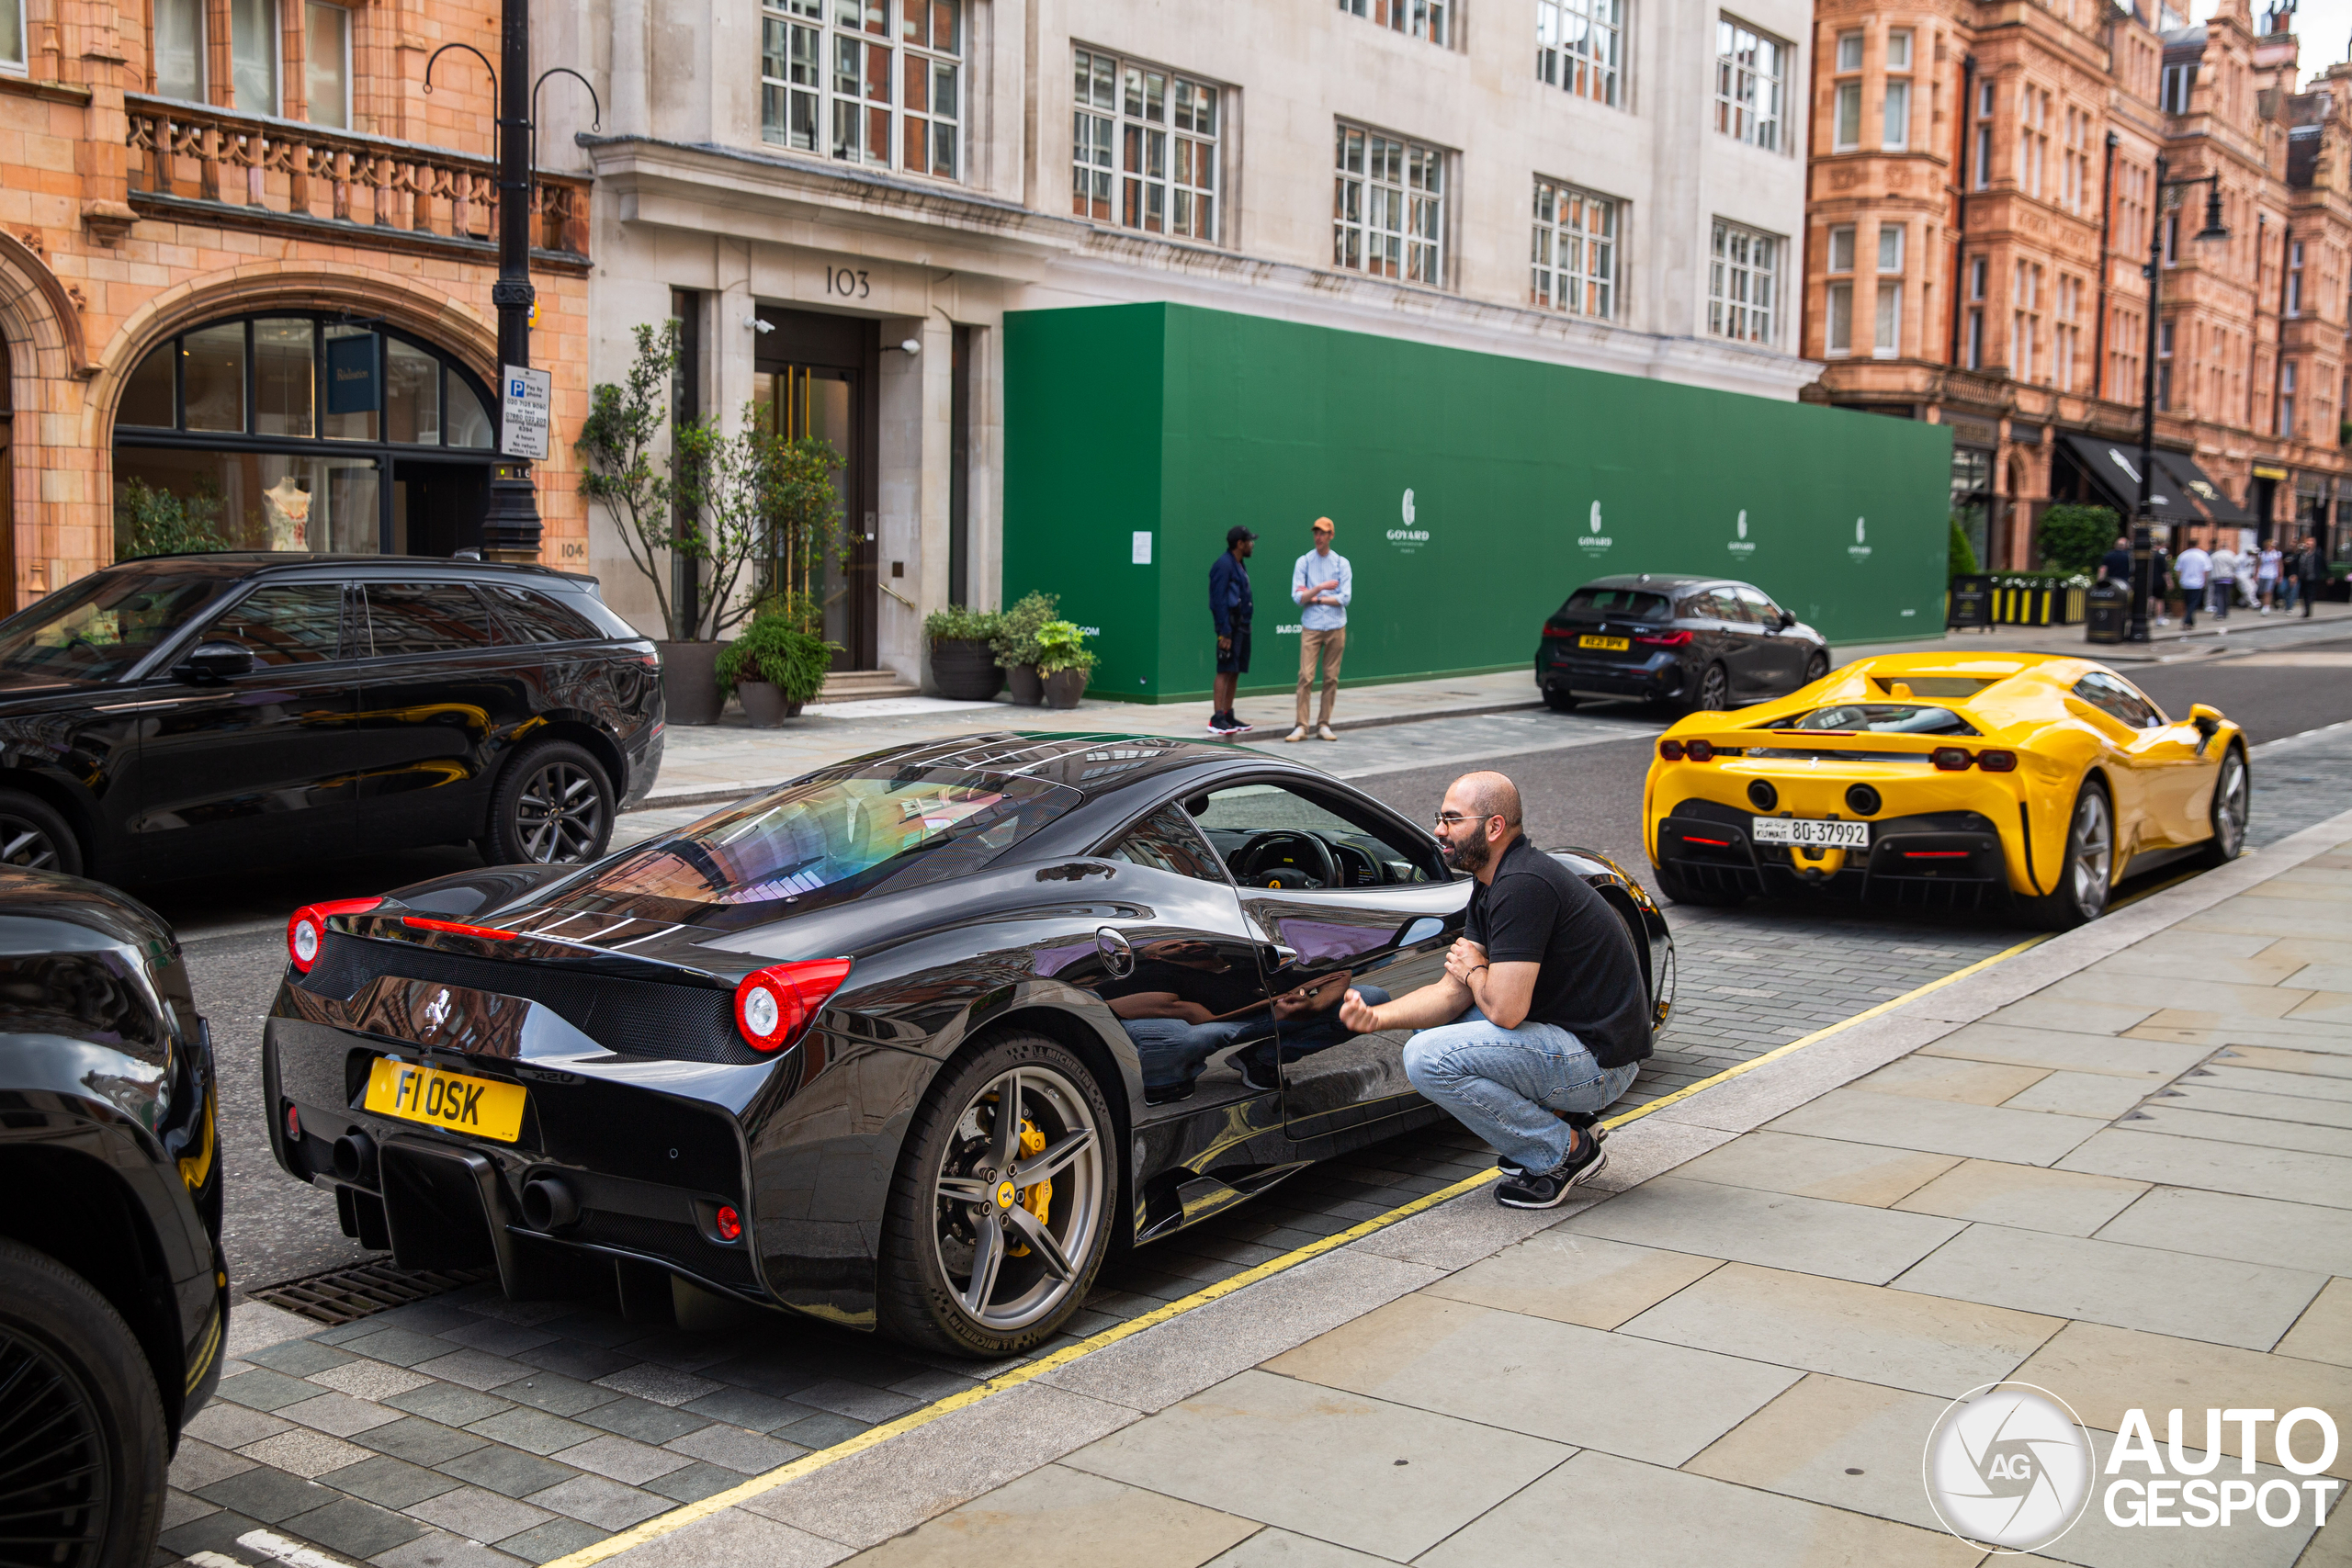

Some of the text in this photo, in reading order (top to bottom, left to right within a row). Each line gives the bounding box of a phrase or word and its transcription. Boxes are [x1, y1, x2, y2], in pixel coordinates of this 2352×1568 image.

[827, 265, 870, 299] 103
[526, 384, 536, 392] Pay
[1386, 528, 1430, 542] GOYARD
[561, 543, 583, 558] 104
[1756, 829, 1787, 839] KUWAIT
[1792, 821, 1864, 844] 80-37992
[1046, 1047, 1092, 1089] MICHELIN
[947, 1314, 1001, 1350] MICHELIN
